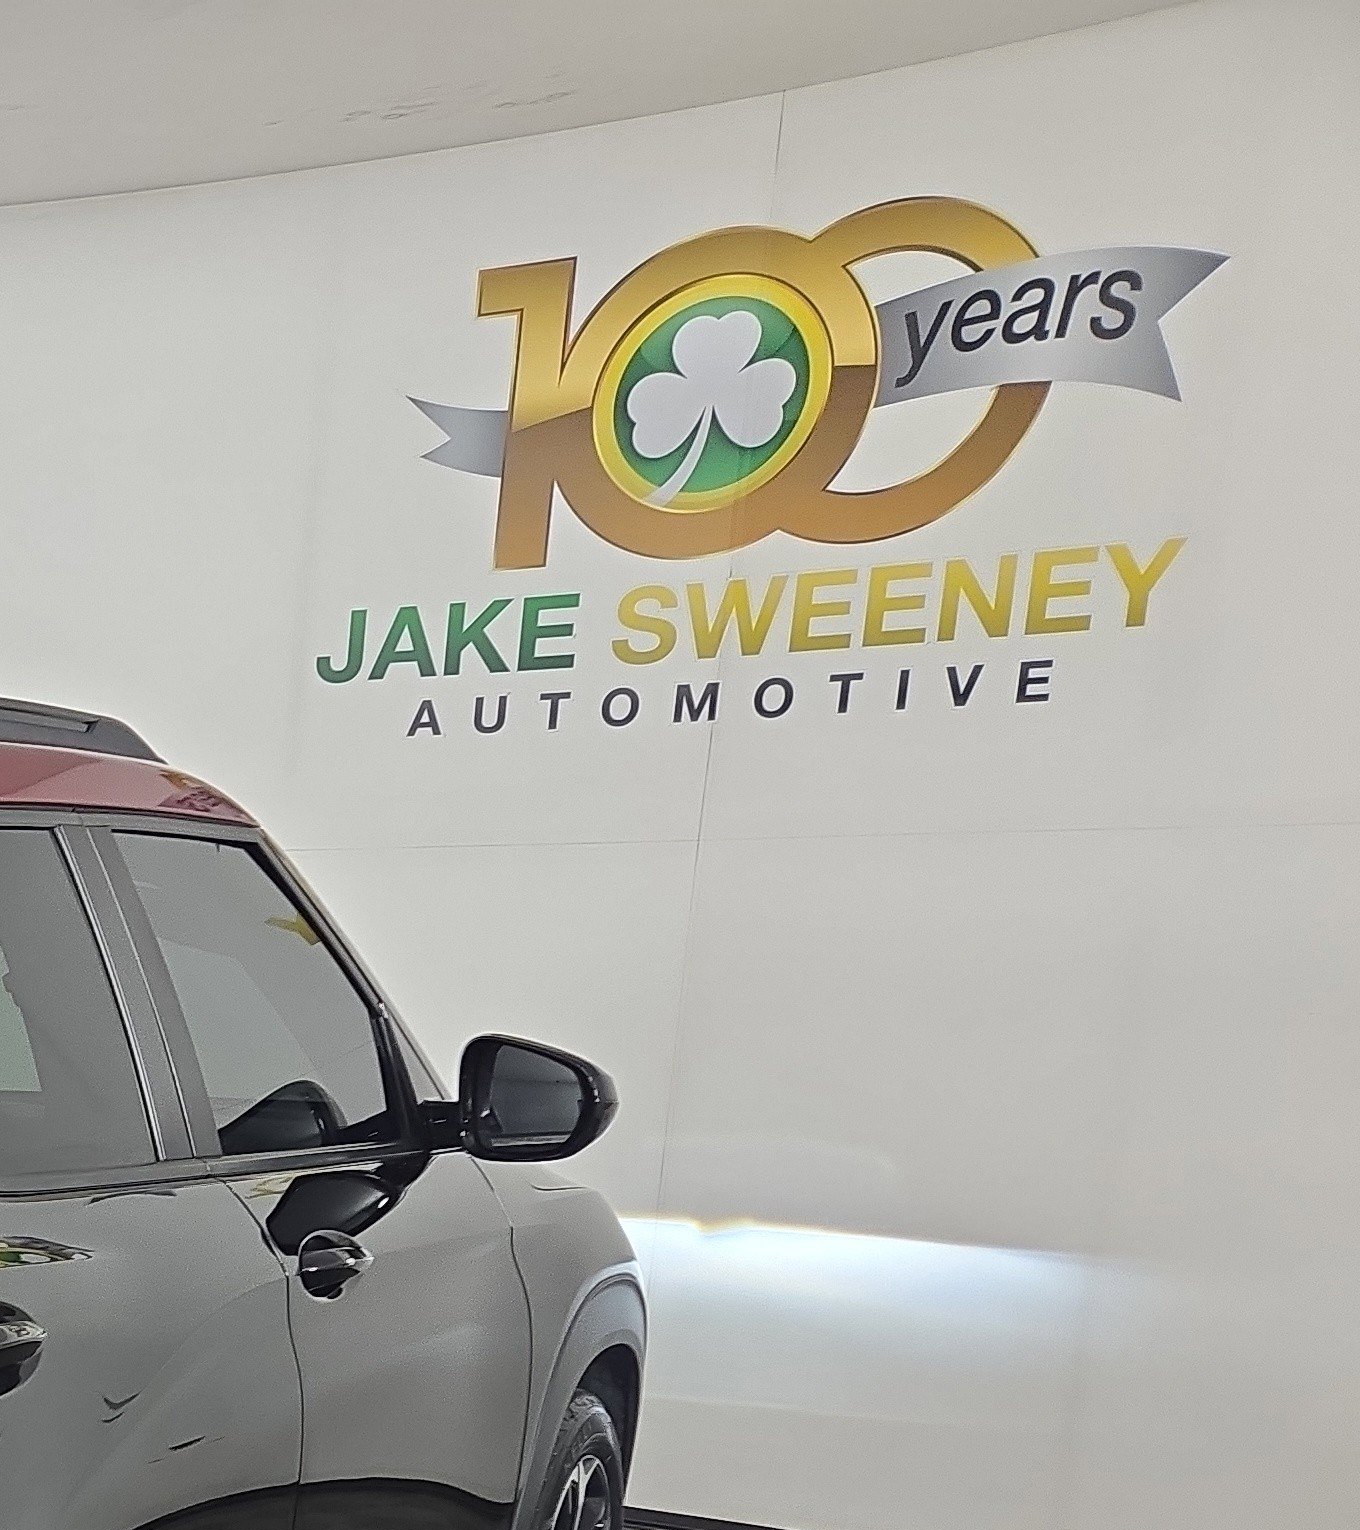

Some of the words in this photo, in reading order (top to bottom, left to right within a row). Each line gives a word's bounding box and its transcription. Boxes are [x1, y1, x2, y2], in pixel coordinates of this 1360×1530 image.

[477, 195, 1056, 570] 100
[895, 266, 1144, 389] years
[316, 593, 580, 684] JAKE
[612, 537, 1188, 666] SWEENEY
[406, 660, 1054, 738] AUTOMOTIVE
